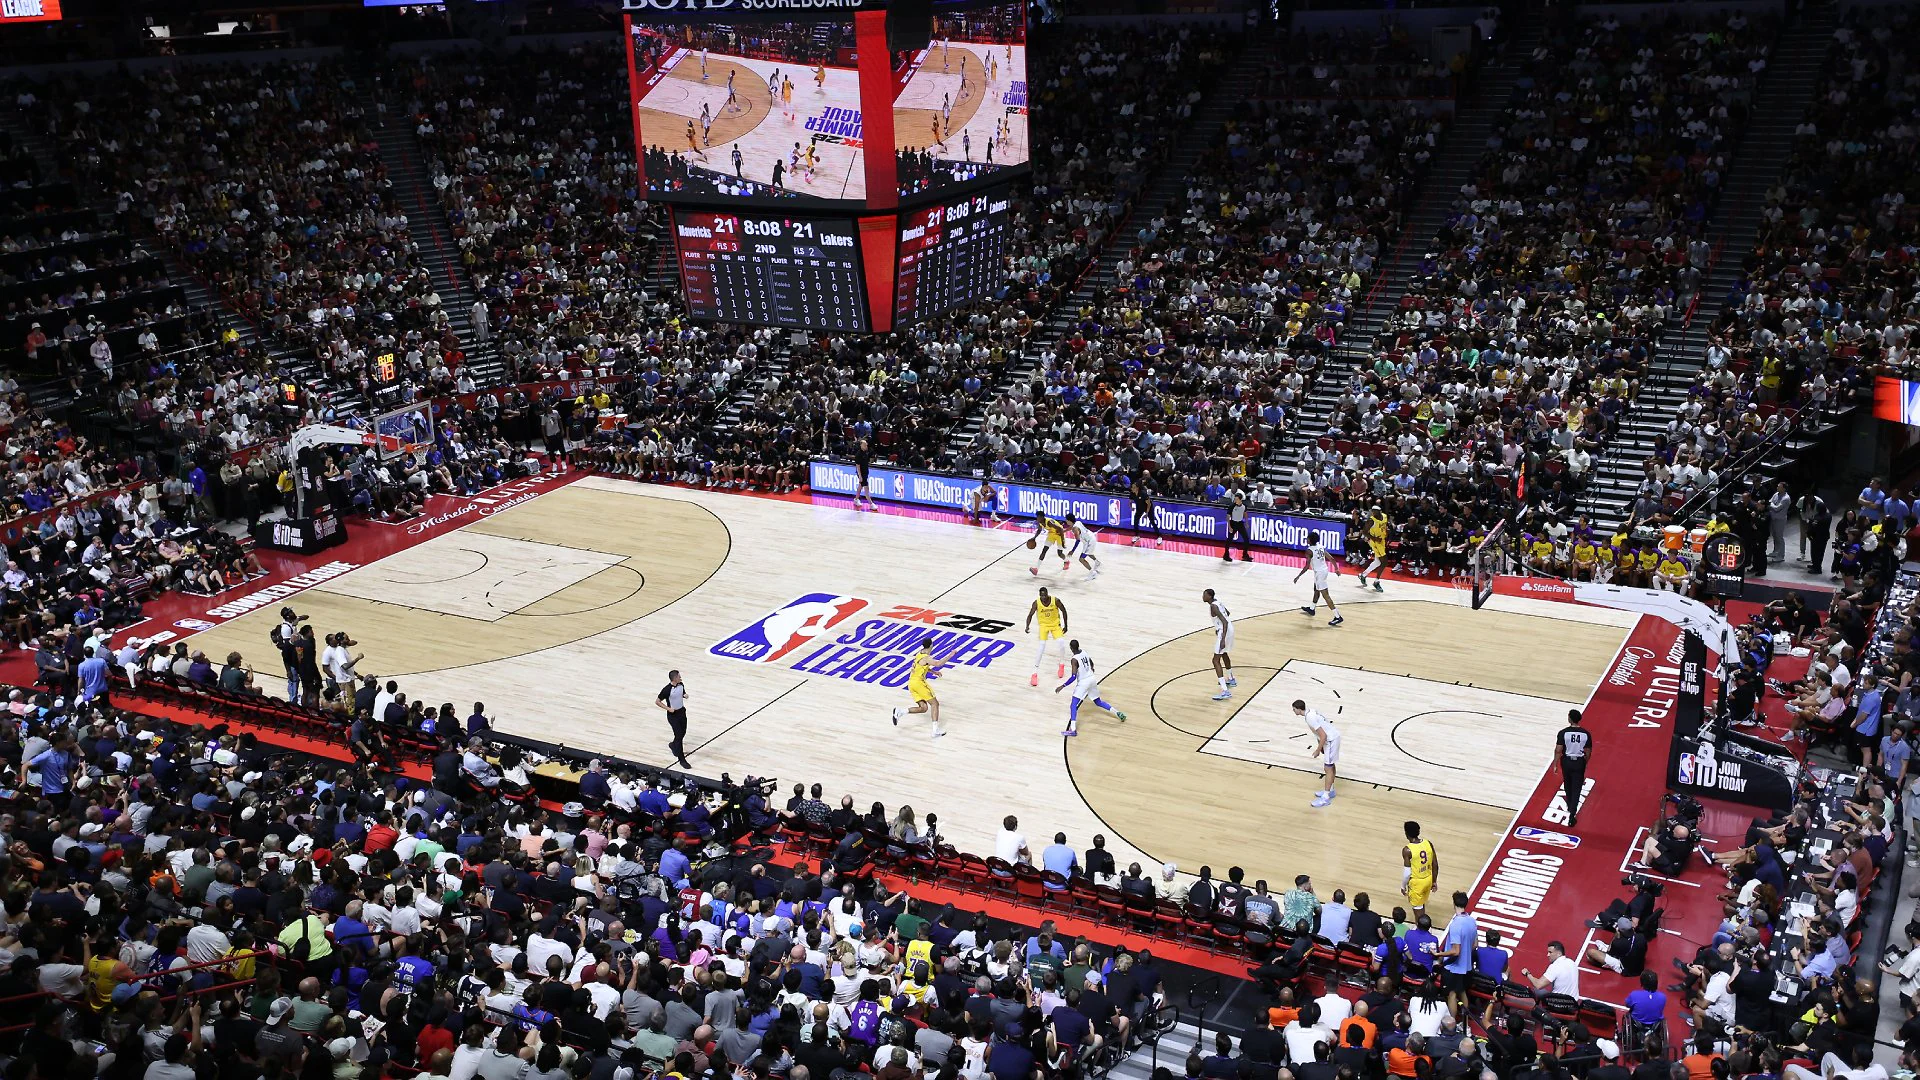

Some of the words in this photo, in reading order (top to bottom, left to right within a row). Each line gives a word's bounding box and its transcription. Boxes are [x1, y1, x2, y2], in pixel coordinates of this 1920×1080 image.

[2, 0, 44, 17] LEAGUE
[928, 210, 940, 228] 21
[946, 202, 969, 222] 8:08
[975, 196, 987, 213] 21
[678, 224, 712, 238] Mavericks
[714, 218, 734, 234] 21
[744, 220, 781, 236] 8:08
[792, 222, 813, 238] 21
[820, 233, 853, 247] Lakers
[950, 227, 963, 238] 2ND
[755, 244, 776, 254] 2ND
[808, 248, 814, 256] 2
[726, 265, 730, 273] 1
[741, 266, 746, 274] 1
[756, 267, 761, 275] 0
[815, 270, 819, 279] 1
[831, 272, 836, 280] 1
[847, 272, 851, 281] 1
[712, 275, 717, 283] 3
[743, 277, 748, 285] 1
[800, 281, 805, 289] 3
[816, 282, 821, 291] 0
[832, 283, 837, 292] 0
[730, 288, 734, 296] 1
[745, 289, 750, 297] 0
[760, 290, 765, 298] 2
[802, 293, 806, 302] 0
[818, 295, 823, 303] 2
[834, 296, 839, 304] 0
[850, 297, 854, 305] 1
[716, 298, 721, 306] 0
[718, 309, 723, 317] 0
[763, 313, 768, 321] 3
[803, 305, 808, 313] 3
[820, 306, 825, 314] 3
[836, 307, 840, 316] 0
[852, 309, 856, 317] 1
[821, 318, 826, 326] 0
[837, 319, 842, 327] 0
[853, 320, 858, 328] 0
[407, 503, 478, 534] Michelob
[1718, 544, 1740, 555] 8:08
[1721, 554, 1735, 567] 18
[206, 580, 302, 618] SUMMER
[289, 560, 360, 588] LEAGUE
[878, 605, 1015, 634] 2K26
[718, 639, 766, 657] NBA
[836, 620, 1015, 668] SUMMER
[1608, 646, 1655, 685] Courtside
[1684, 662, 1697, 672] GET
[1684, 672, 1697, 682] THE
[1686, 682, 1699, 695] App
[1628, 677, 1680, 728] ULTRA
[1571, 734, 1580, 744] 64
[1719, 761, 1741, 777] JOIN
[1718, 775, 1747, 792] TODAY
[1419, 850, 1428, 864] 9
[1474, 848, 1563, 918] SUMMER
[858, 1016, 868, 1031] 6
